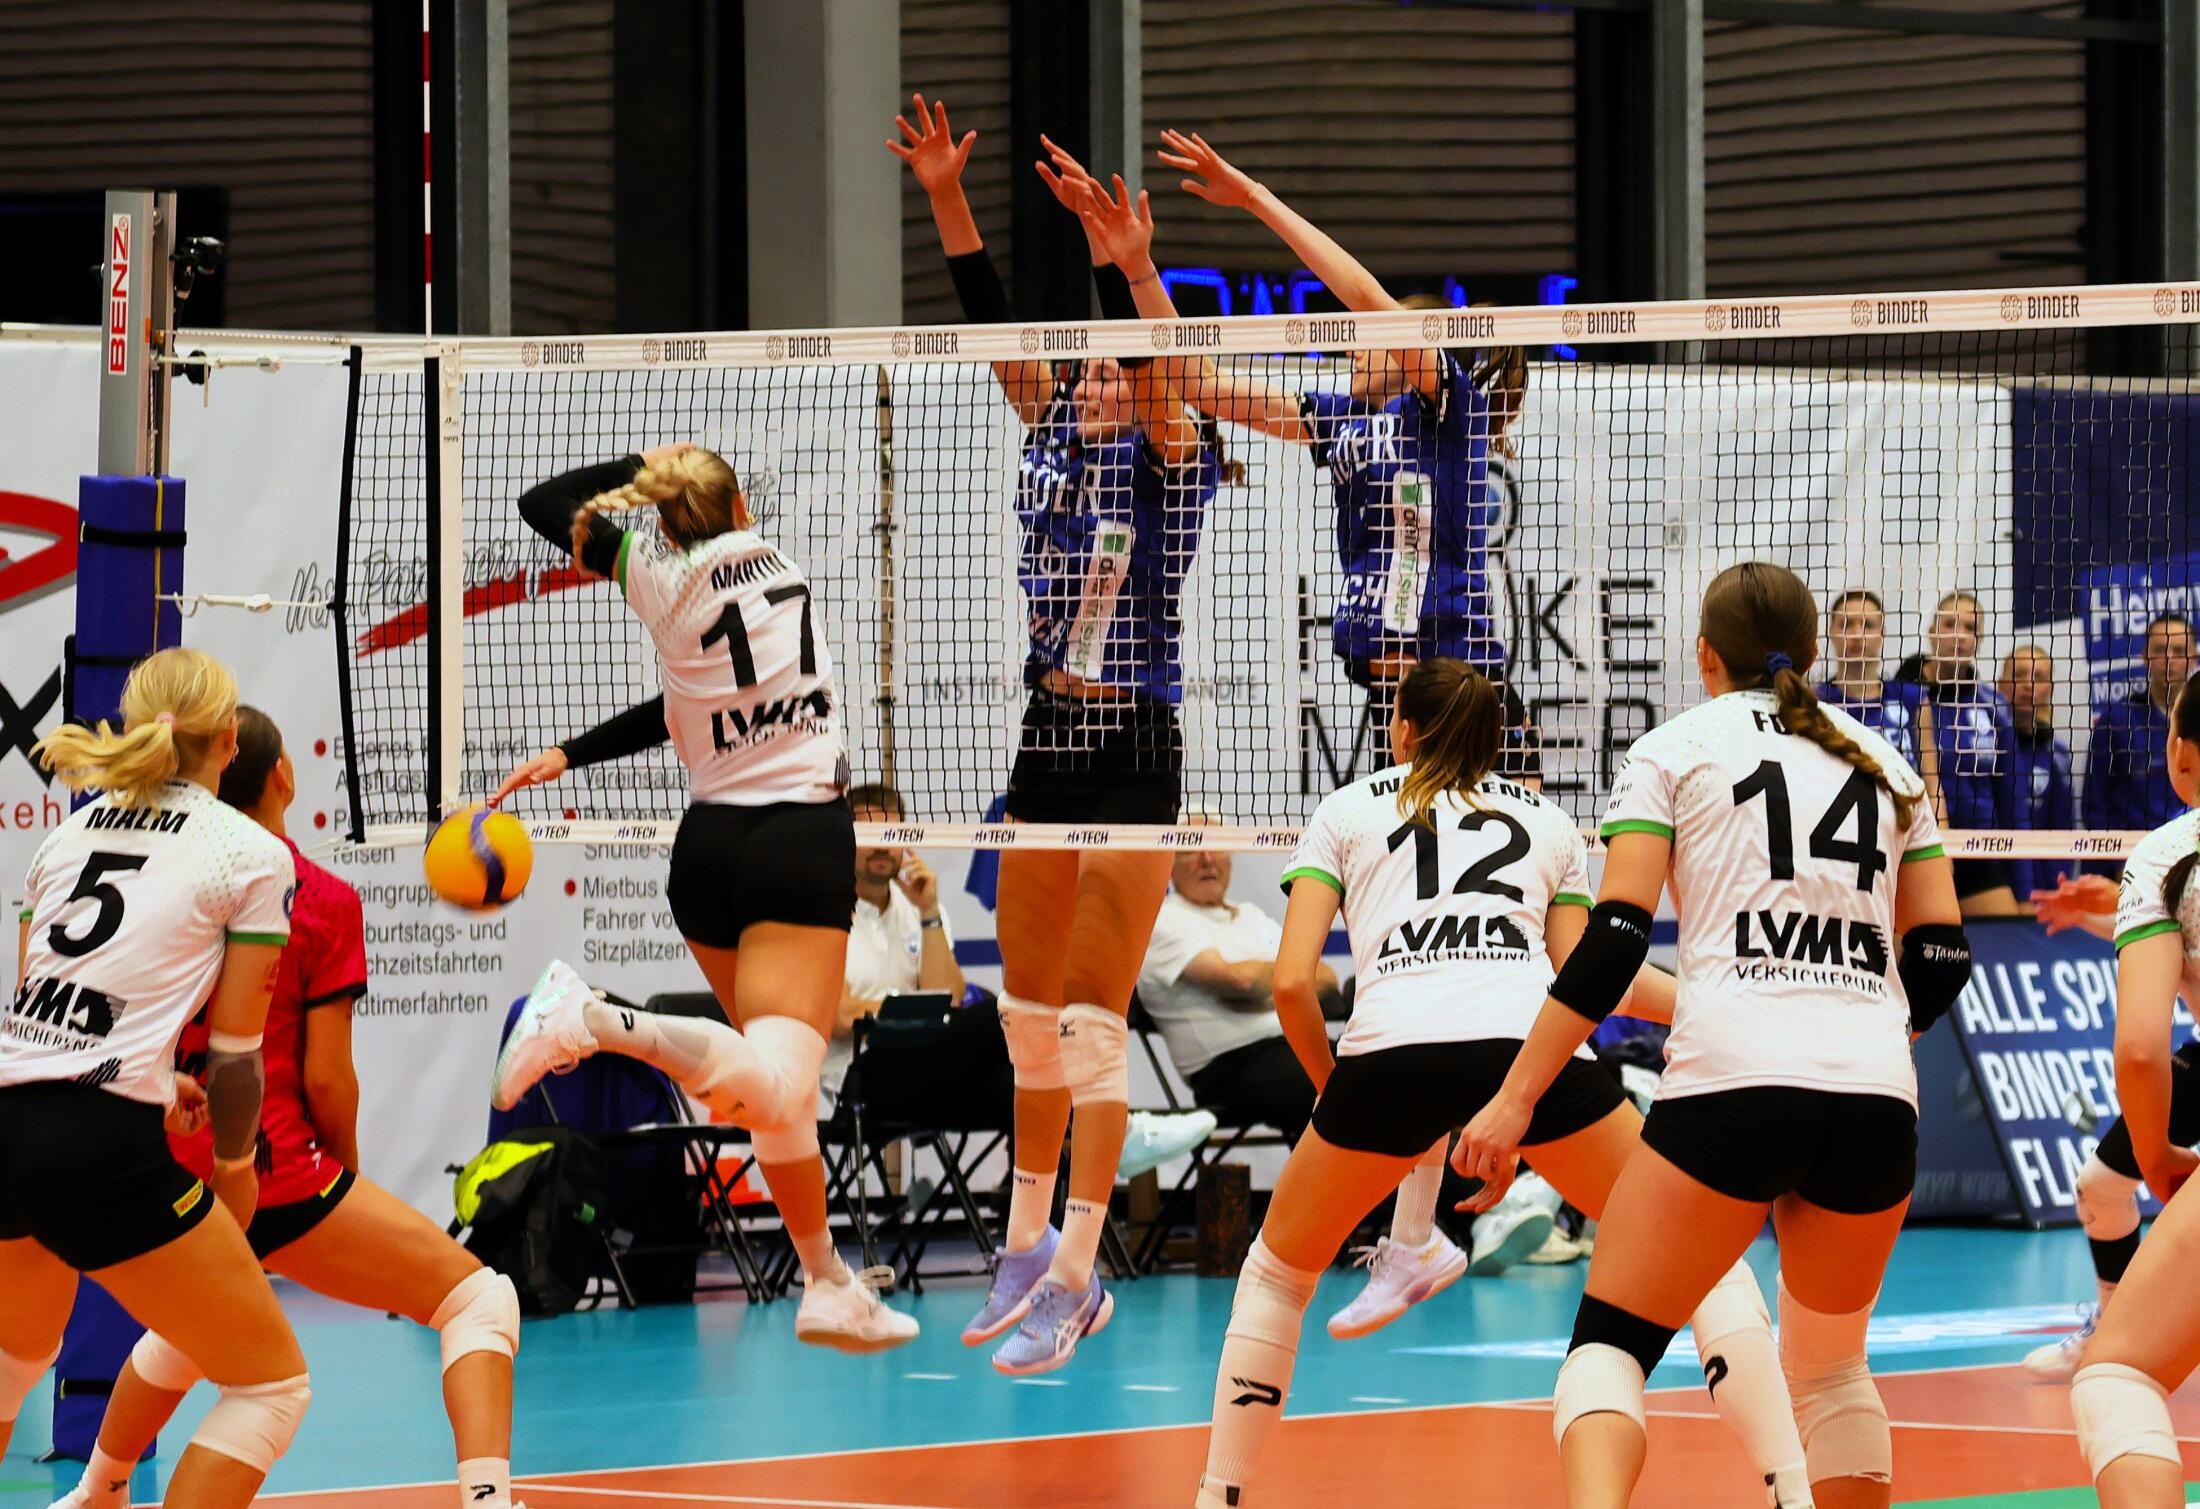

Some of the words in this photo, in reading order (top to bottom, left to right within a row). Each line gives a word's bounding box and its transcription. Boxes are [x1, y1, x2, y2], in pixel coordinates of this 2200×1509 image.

[110, 226, 129, 372] BENZ
[1877, 299, 1929, 325] BINDER
[2027, 294, 2080, 320] BINDER
[1446, 315, 1495, 339] BINDER
[1587, 310, 1636, 334] BINDER
[1730, 304, 1781, 330] BINDER
[914, 332, 958, 355] BINDER
[1043, 328, 1089, 351] BINDER
[1175, 324, 1221, 348] BINDER
[1309, 320, 1356, 344] BINDER
[543, 342, 585, 364] BINDER
[664, 339, 707, 361] BINDER
[788, 336, 832, 358] BINDER
[700, 584, 817, 690] 17
[84, 807, 190, 834] MALM
[1732, 759, 1888, 896] 14
[1387, 808, 1531, 905] 12
[583, 876, 658, 899] Mietbus
[48, 851, 150, 958] 5
[583, 907, 646, 930] Fahrer
[366, 921, 463, 948] burtstags-
[470, 918, 506, 941] und
[1378, 914, 1481, 960] LVM
[1736, 909, 1844, 966] LVM
[367, 951, 502, 976] chzeitsfahrten
[584, 937, 687, 966] Sitzplätzen
[1959, 962, 2058, 1035] ALLE
